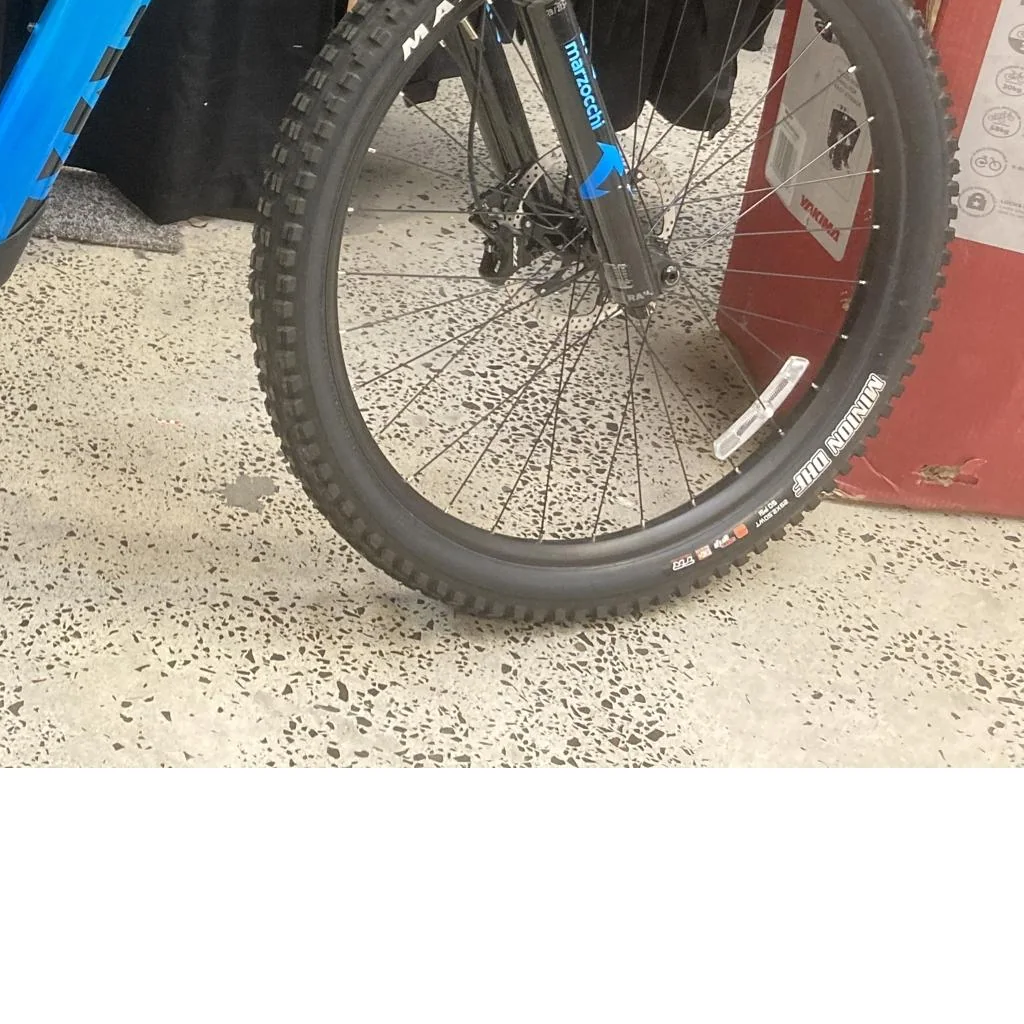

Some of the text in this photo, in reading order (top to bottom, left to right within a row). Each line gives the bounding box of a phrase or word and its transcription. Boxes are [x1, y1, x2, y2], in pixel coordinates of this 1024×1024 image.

[565, 40, 606, 131] marzocchi
[799, 194, 842, 243] YAKIMA
[792, 372, 887, 498] MINION DHF
